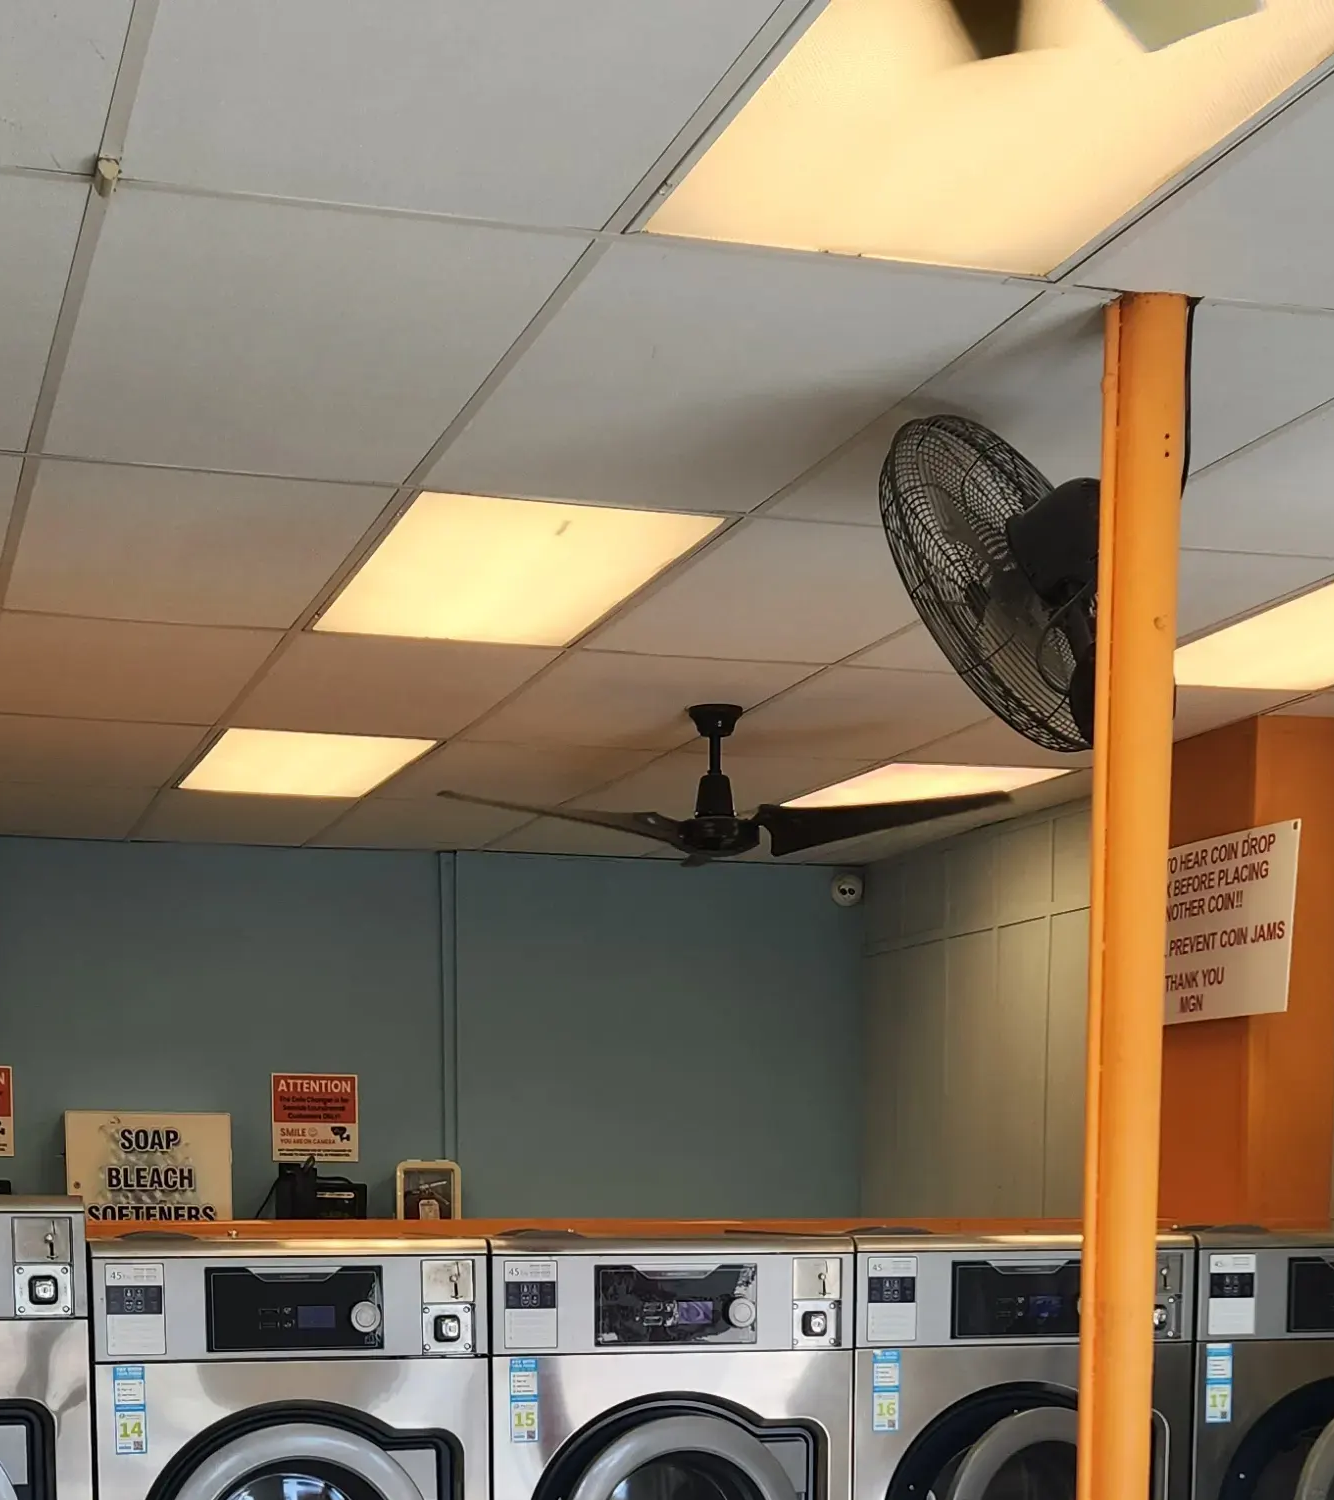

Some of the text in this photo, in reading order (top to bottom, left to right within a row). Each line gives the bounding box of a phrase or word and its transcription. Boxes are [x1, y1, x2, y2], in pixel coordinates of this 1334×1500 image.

[1180, 849, 1207, 872] HEAR
[1211, 844, 1237, 866] COIN
[1242, 833, 1275, 858] DROP
[1174, 872, 1215, 897] BEFORE
[1217, 860, 1269, 888] PLACING
[1166, 890, 1243, 922] NOTHER COIN!!
[1169, 921, 1285, 957] PREVENT COIN JAMS
[1165, 966, 1225, 992] THANK YOU
[278, 1079, 351, 1092] ATTENTION
[120, 1128, 180, 1151] SOAP
[280, 1128, 307, 1136] SMILE
[107, 1167, 193, 1188] BLEACH
[88, 1205, 216, 1221] SOFTENERS
[111, 1271, 122, 1280] 45
[509, 1268, 520, 1276] 45
[872, 1264, 883, 1272] 45
[876, 1402, 896, 1416] 16
[1209, 1394, 1228, 1408] 17
[515, 1412, 535, 1427] 15
[119, 1421, 143, 1438] 14
